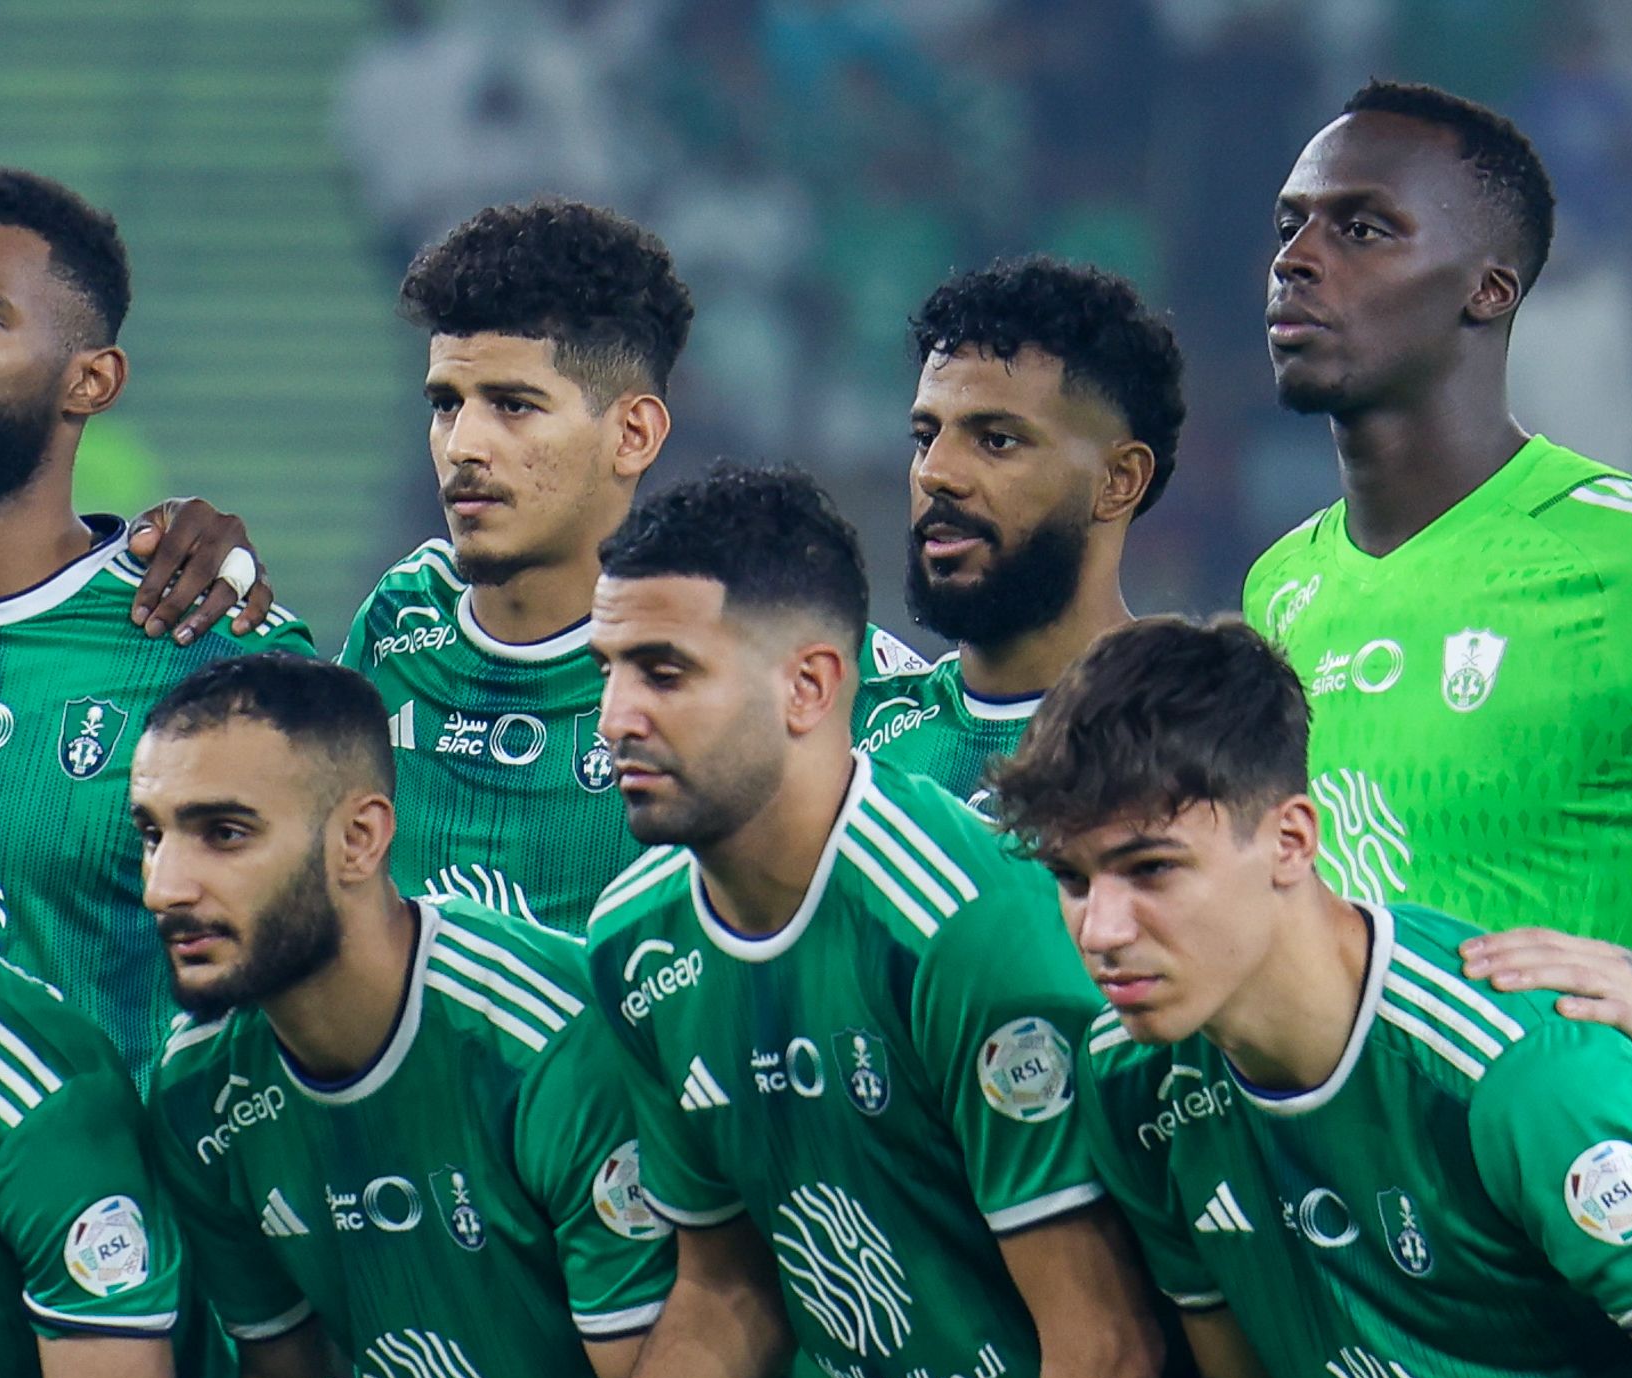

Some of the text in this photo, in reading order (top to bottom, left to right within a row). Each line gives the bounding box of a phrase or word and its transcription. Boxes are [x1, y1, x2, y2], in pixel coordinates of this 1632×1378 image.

[373, 624, 457, 668] neoleap
[1311, 672, 1347, 697] SIRC
[435, 735, 484, 756] SIRC
[1010, 1057, 1048, 1084] RSL
[98, 1235, 131, 1261] RSL
